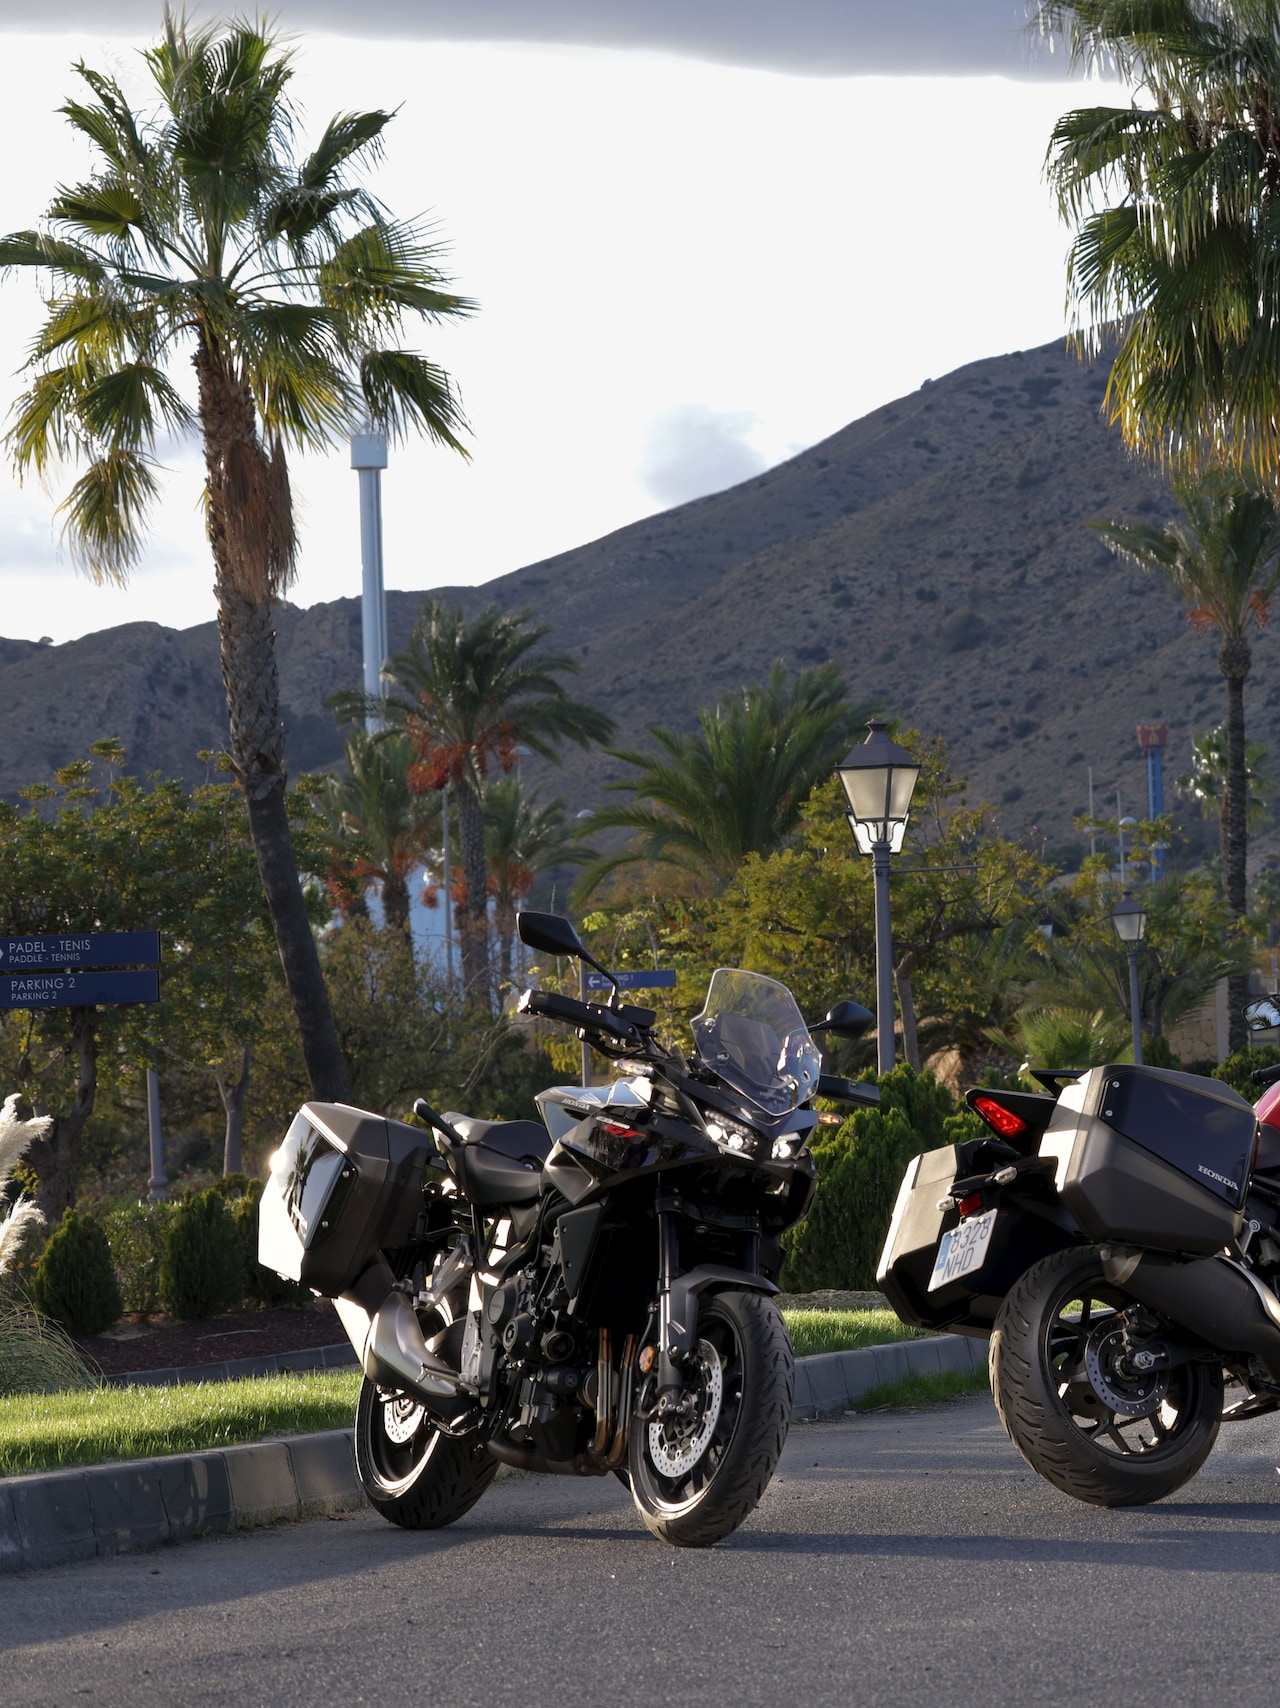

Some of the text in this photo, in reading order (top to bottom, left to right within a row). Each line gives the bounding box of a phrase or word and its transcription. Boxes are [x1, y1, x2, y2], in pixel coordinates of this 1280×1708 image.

[9, 941, 47, 953] PADEL
[59, 939, 91, 951] TENIS
[9, 954, 43, 963] PADDLE
[51, 952, 81, 962] TENNIS
[11, 977, 76, 991] PARKING 2
[11, 990, 57, 1001] PARKING 2
[561, 1098, 591, 1111] HONDA
[1198, 1164, 1239, 1191] HONDA
[950, 1216, 992, 1254] 8328
[942, 1247, 975, 1280] NHD
